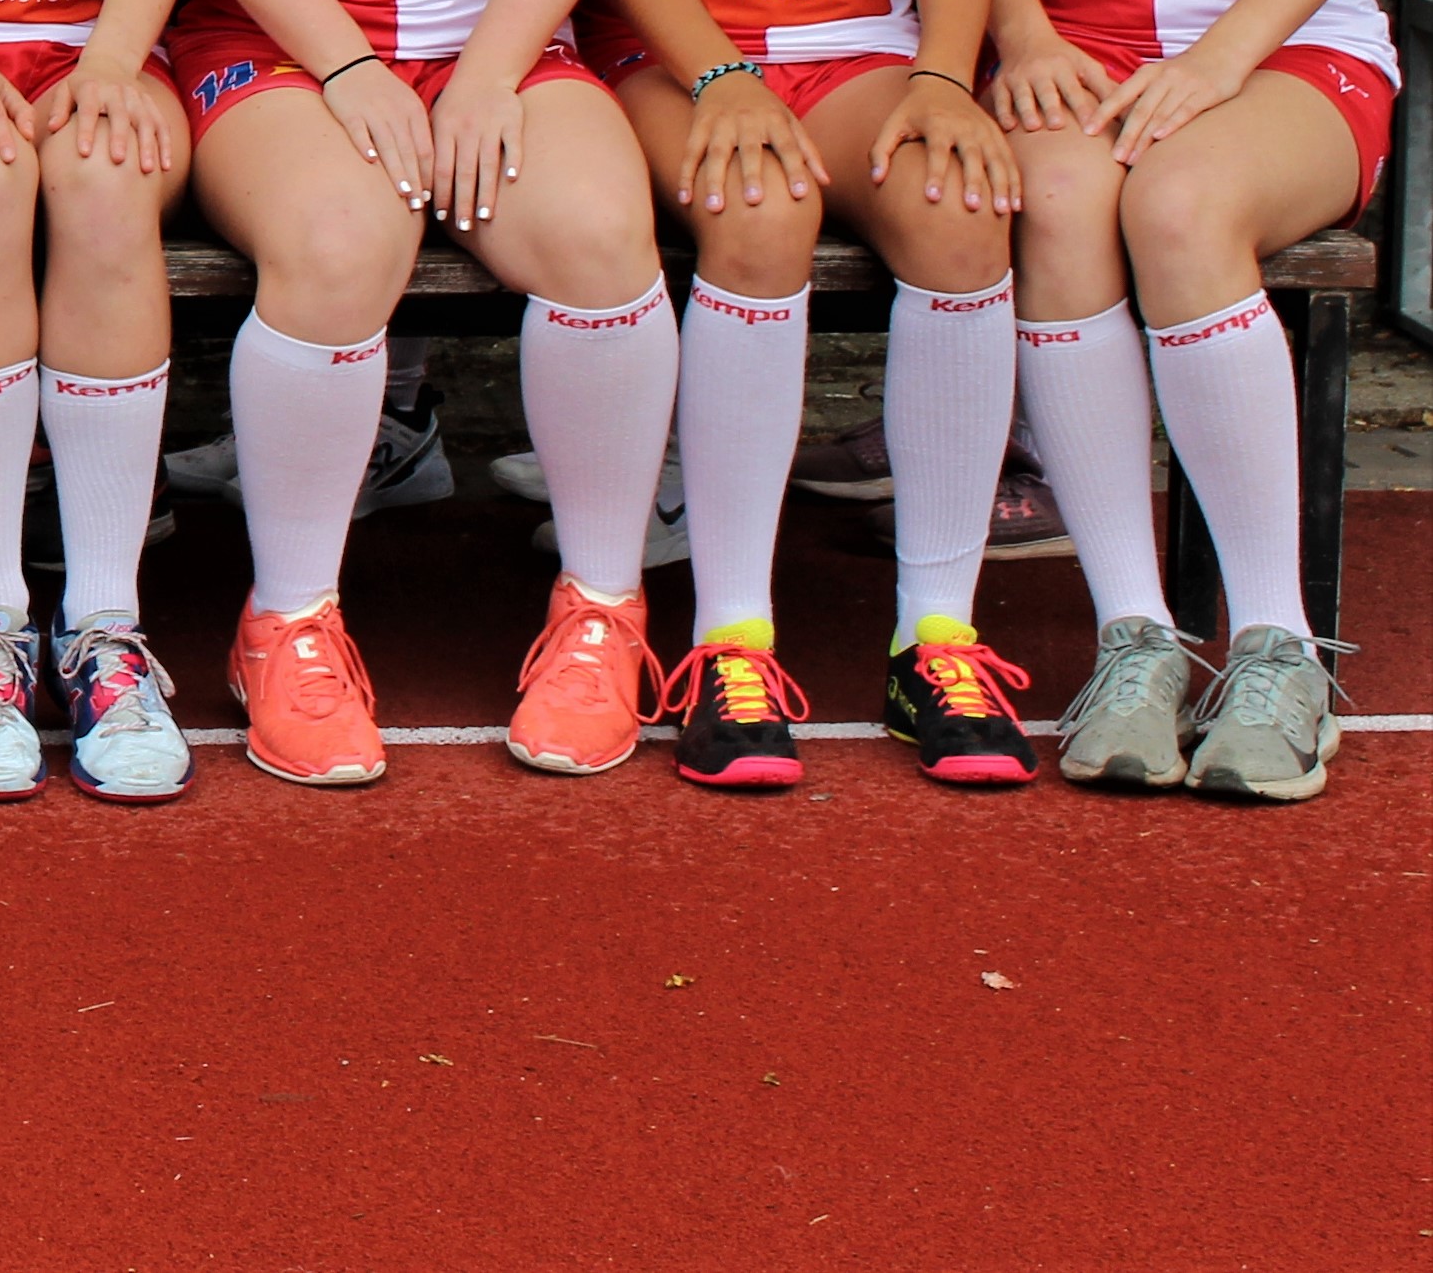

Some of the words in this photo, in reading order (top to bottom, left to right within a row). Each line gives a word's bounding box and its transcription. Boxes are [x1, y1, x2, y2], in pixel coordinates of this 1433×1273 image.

[192, 60, 258, 116] 14
[546, 292, 665, 331] Kempa
[1157, 299, 1269, 348] Kempa
